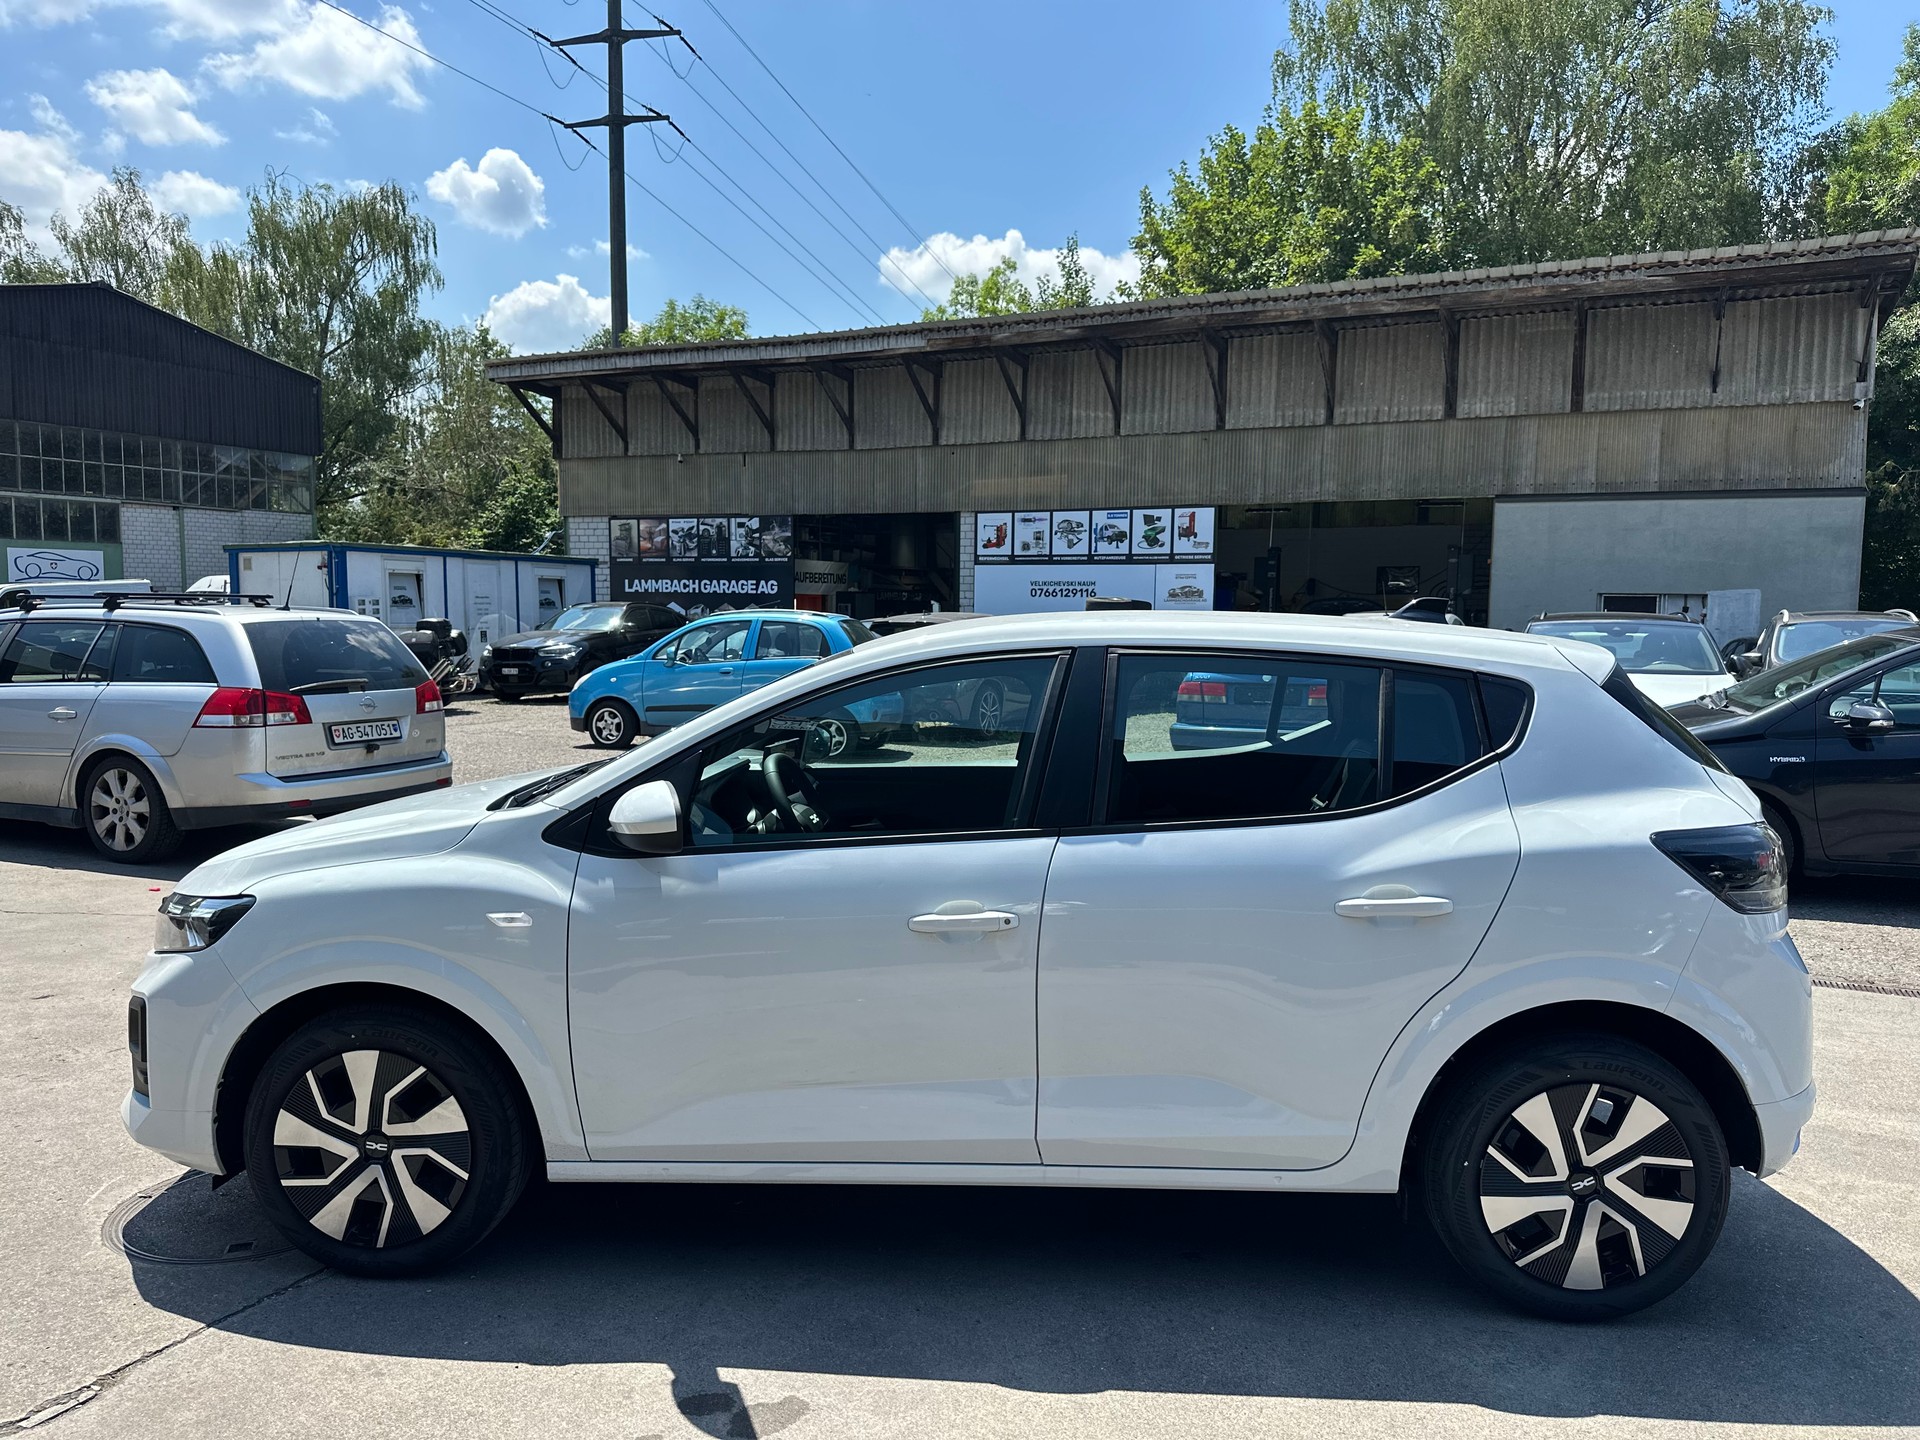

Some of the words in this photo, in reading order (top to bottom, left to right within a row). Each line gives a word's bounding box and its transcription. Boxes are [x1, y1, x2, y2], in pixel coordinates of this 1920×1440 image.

[795, 571, 847, 584] AUFBEREITUNG
[624, 579, 699, 593] LAMMBACH
[701, 580, 757, 594] GARAGE
[757, 580, 778, 595] AG
[1030, 588, 1097, 598] 0766129116
